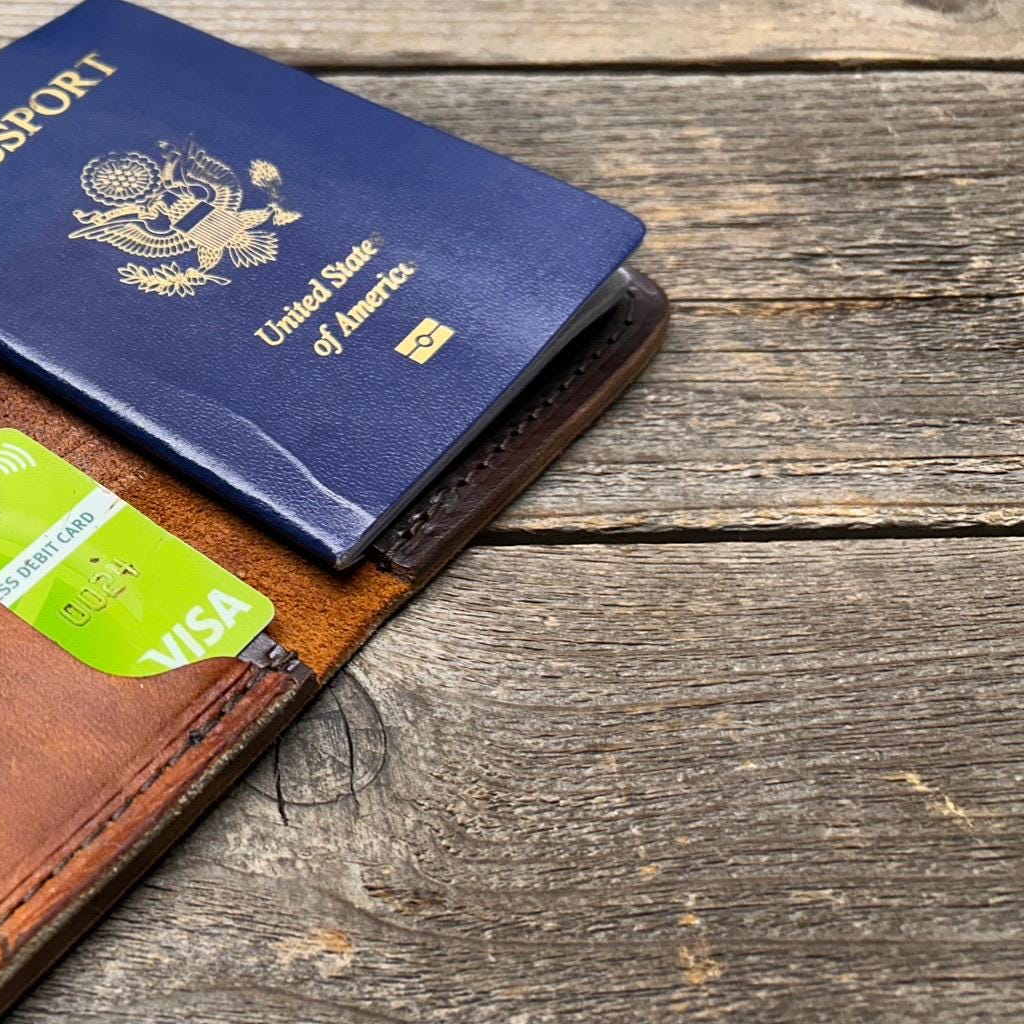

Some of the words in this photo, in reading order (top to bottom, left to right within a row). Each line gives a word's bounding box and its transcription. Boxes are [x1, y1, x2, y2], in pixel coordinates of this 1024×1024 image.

[254, 278, 332, 346] United
[321, 232, 385, 289] State
[314, 323, 343, 357] of
[16, 541, 59, 578] DEBIT
[56, 512, 95, 543] CARD
[136, 588, 252, 669] VISA
